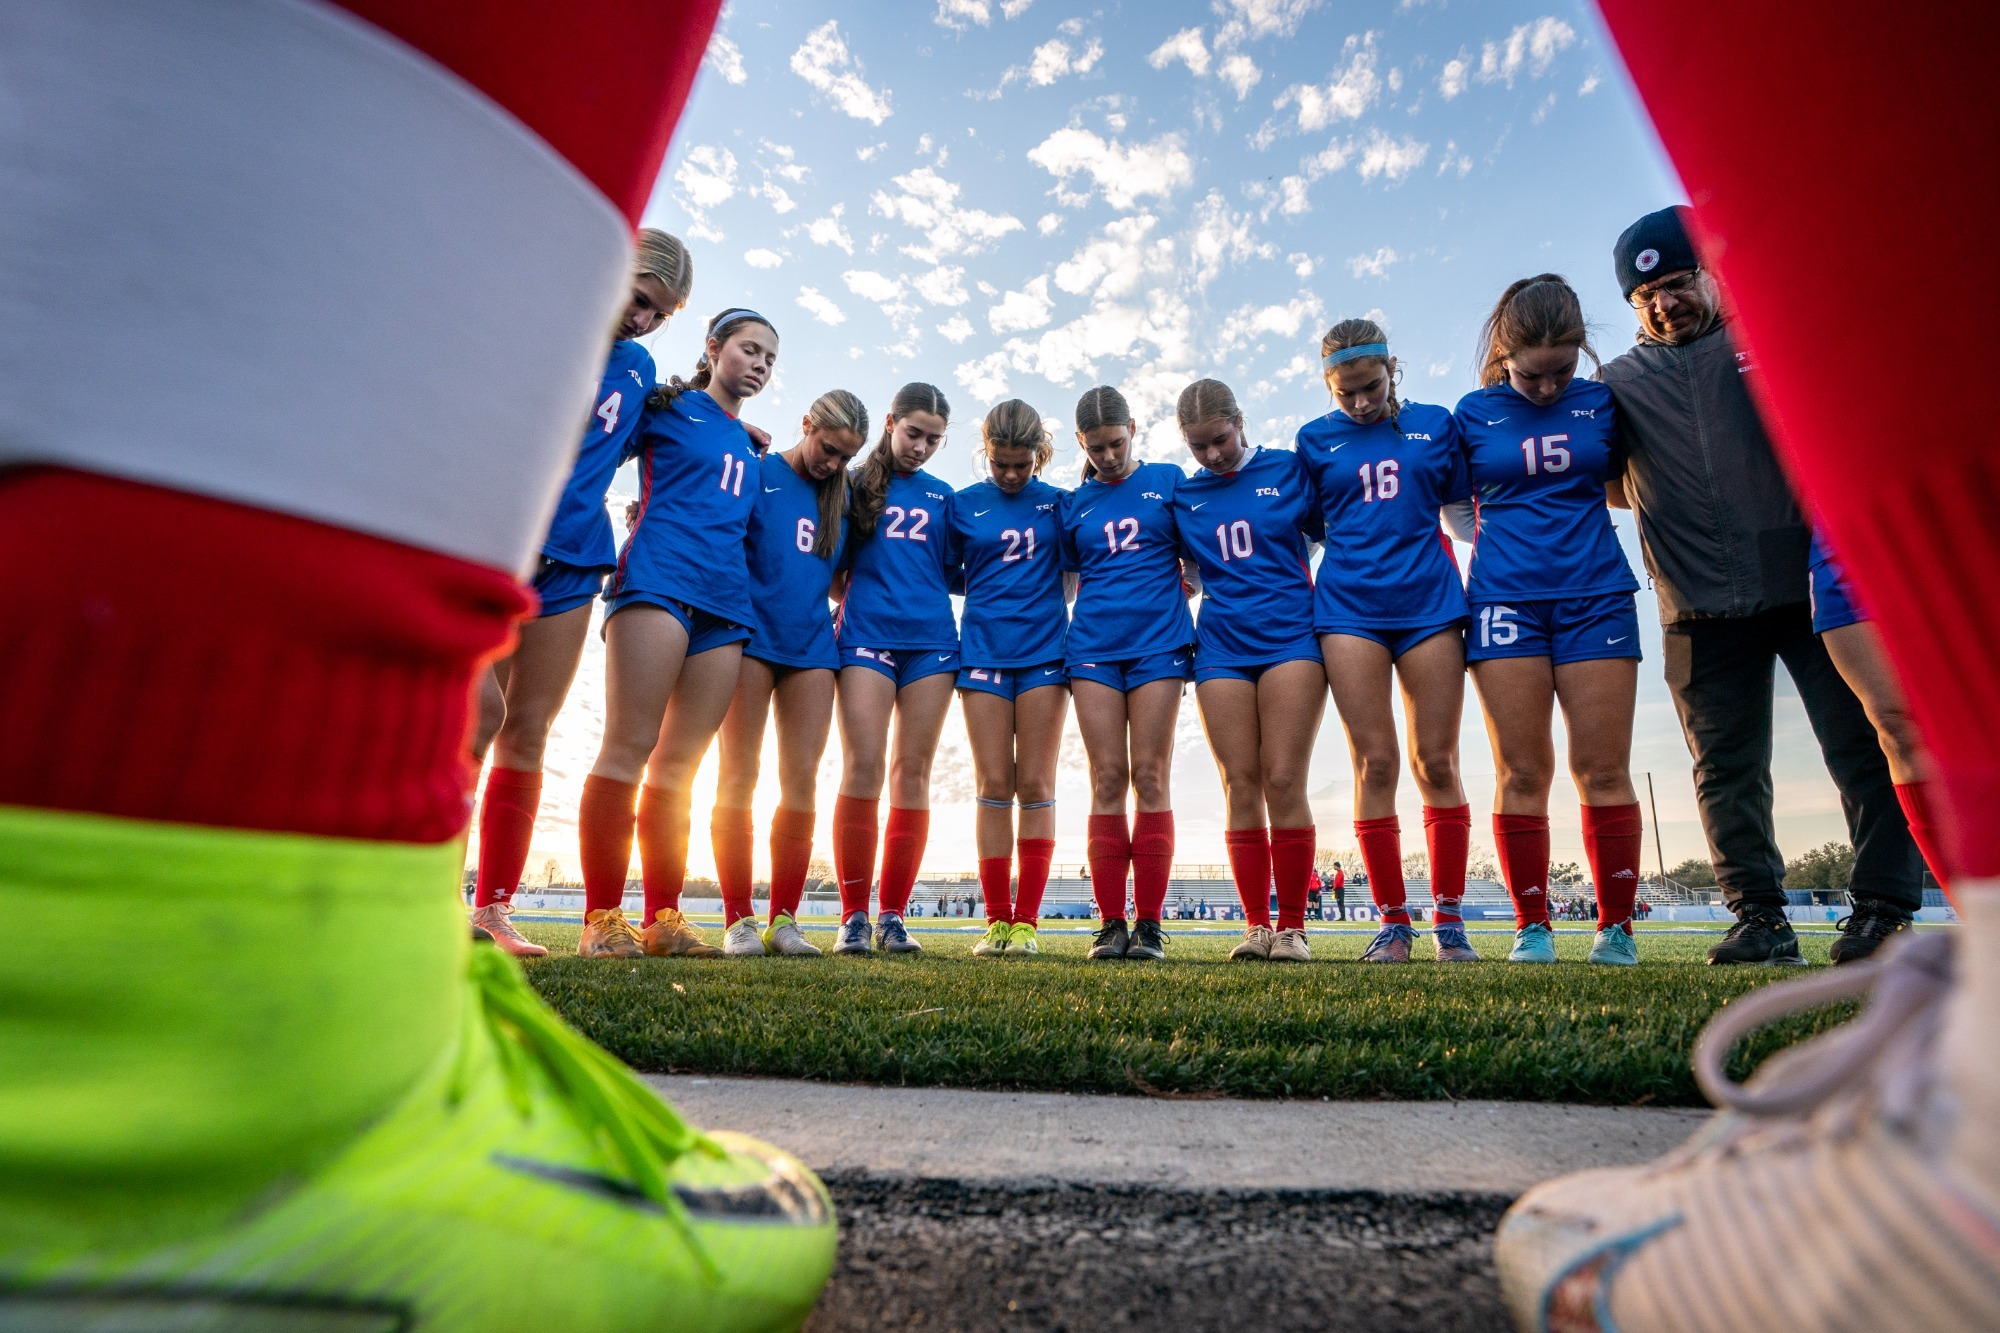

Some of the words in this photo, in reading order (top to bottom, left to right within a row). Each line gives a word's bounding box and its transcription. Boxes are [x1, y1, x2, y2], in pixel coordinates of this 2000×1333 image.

[627, 369, 643, 388] TCA
[1404, 433, 1431, 441] TCA
[1521, 434, 1571, 476] 15
[720, 452, 744, 497] 11
[1255, 487, 1280, 497] TCA
[1358, 458, 1399, 503] 16
[925, 491, 944, 501] TCA
[1141, 491, 1163, 500] TCA
[796, 517, 816, 553] 6
[885, 506, 931, 542] 22
[1103, 517, 1140, 554] 12
[1216, 519, 1254, 562] 10
[1001, 527, 1036, 562] 21
[1479, 605, 1519, 647] 15
